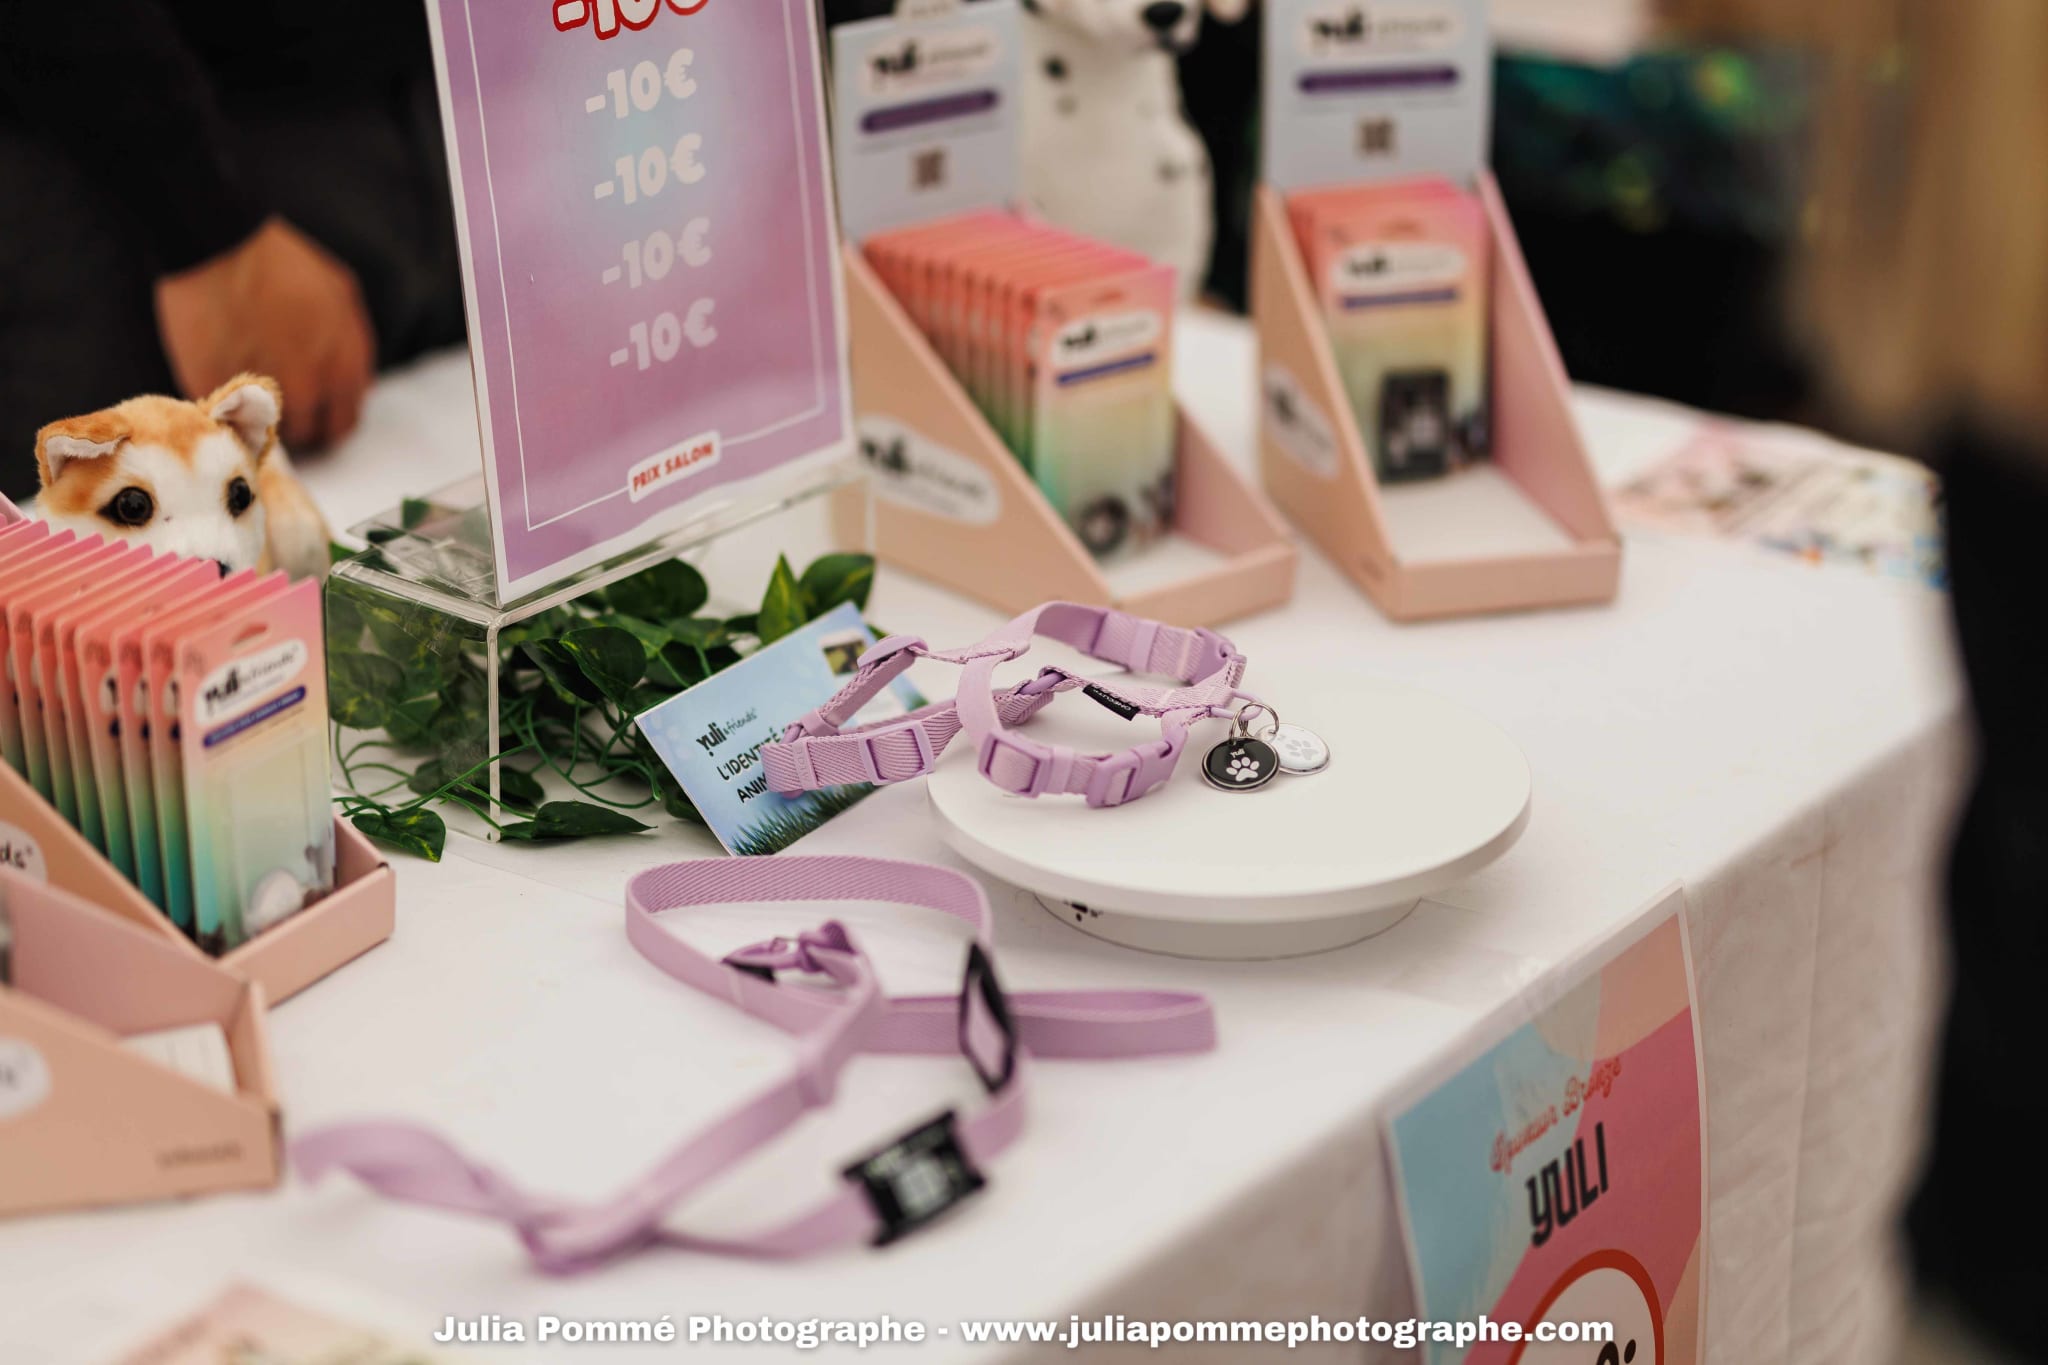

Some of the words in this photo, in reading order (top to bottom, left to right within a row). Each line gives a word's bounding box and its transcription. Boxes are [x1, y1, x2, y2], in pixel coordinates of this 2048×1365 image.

[585, 48, 697, 119] -10€
[594, 132, 706, 204] -10€
[602, 217, 712, 288] -10€
[610, 297, 718, 371] -10€
[633, 464, 660, 492] PRIX
[664, 442, 713, 475] SALON
